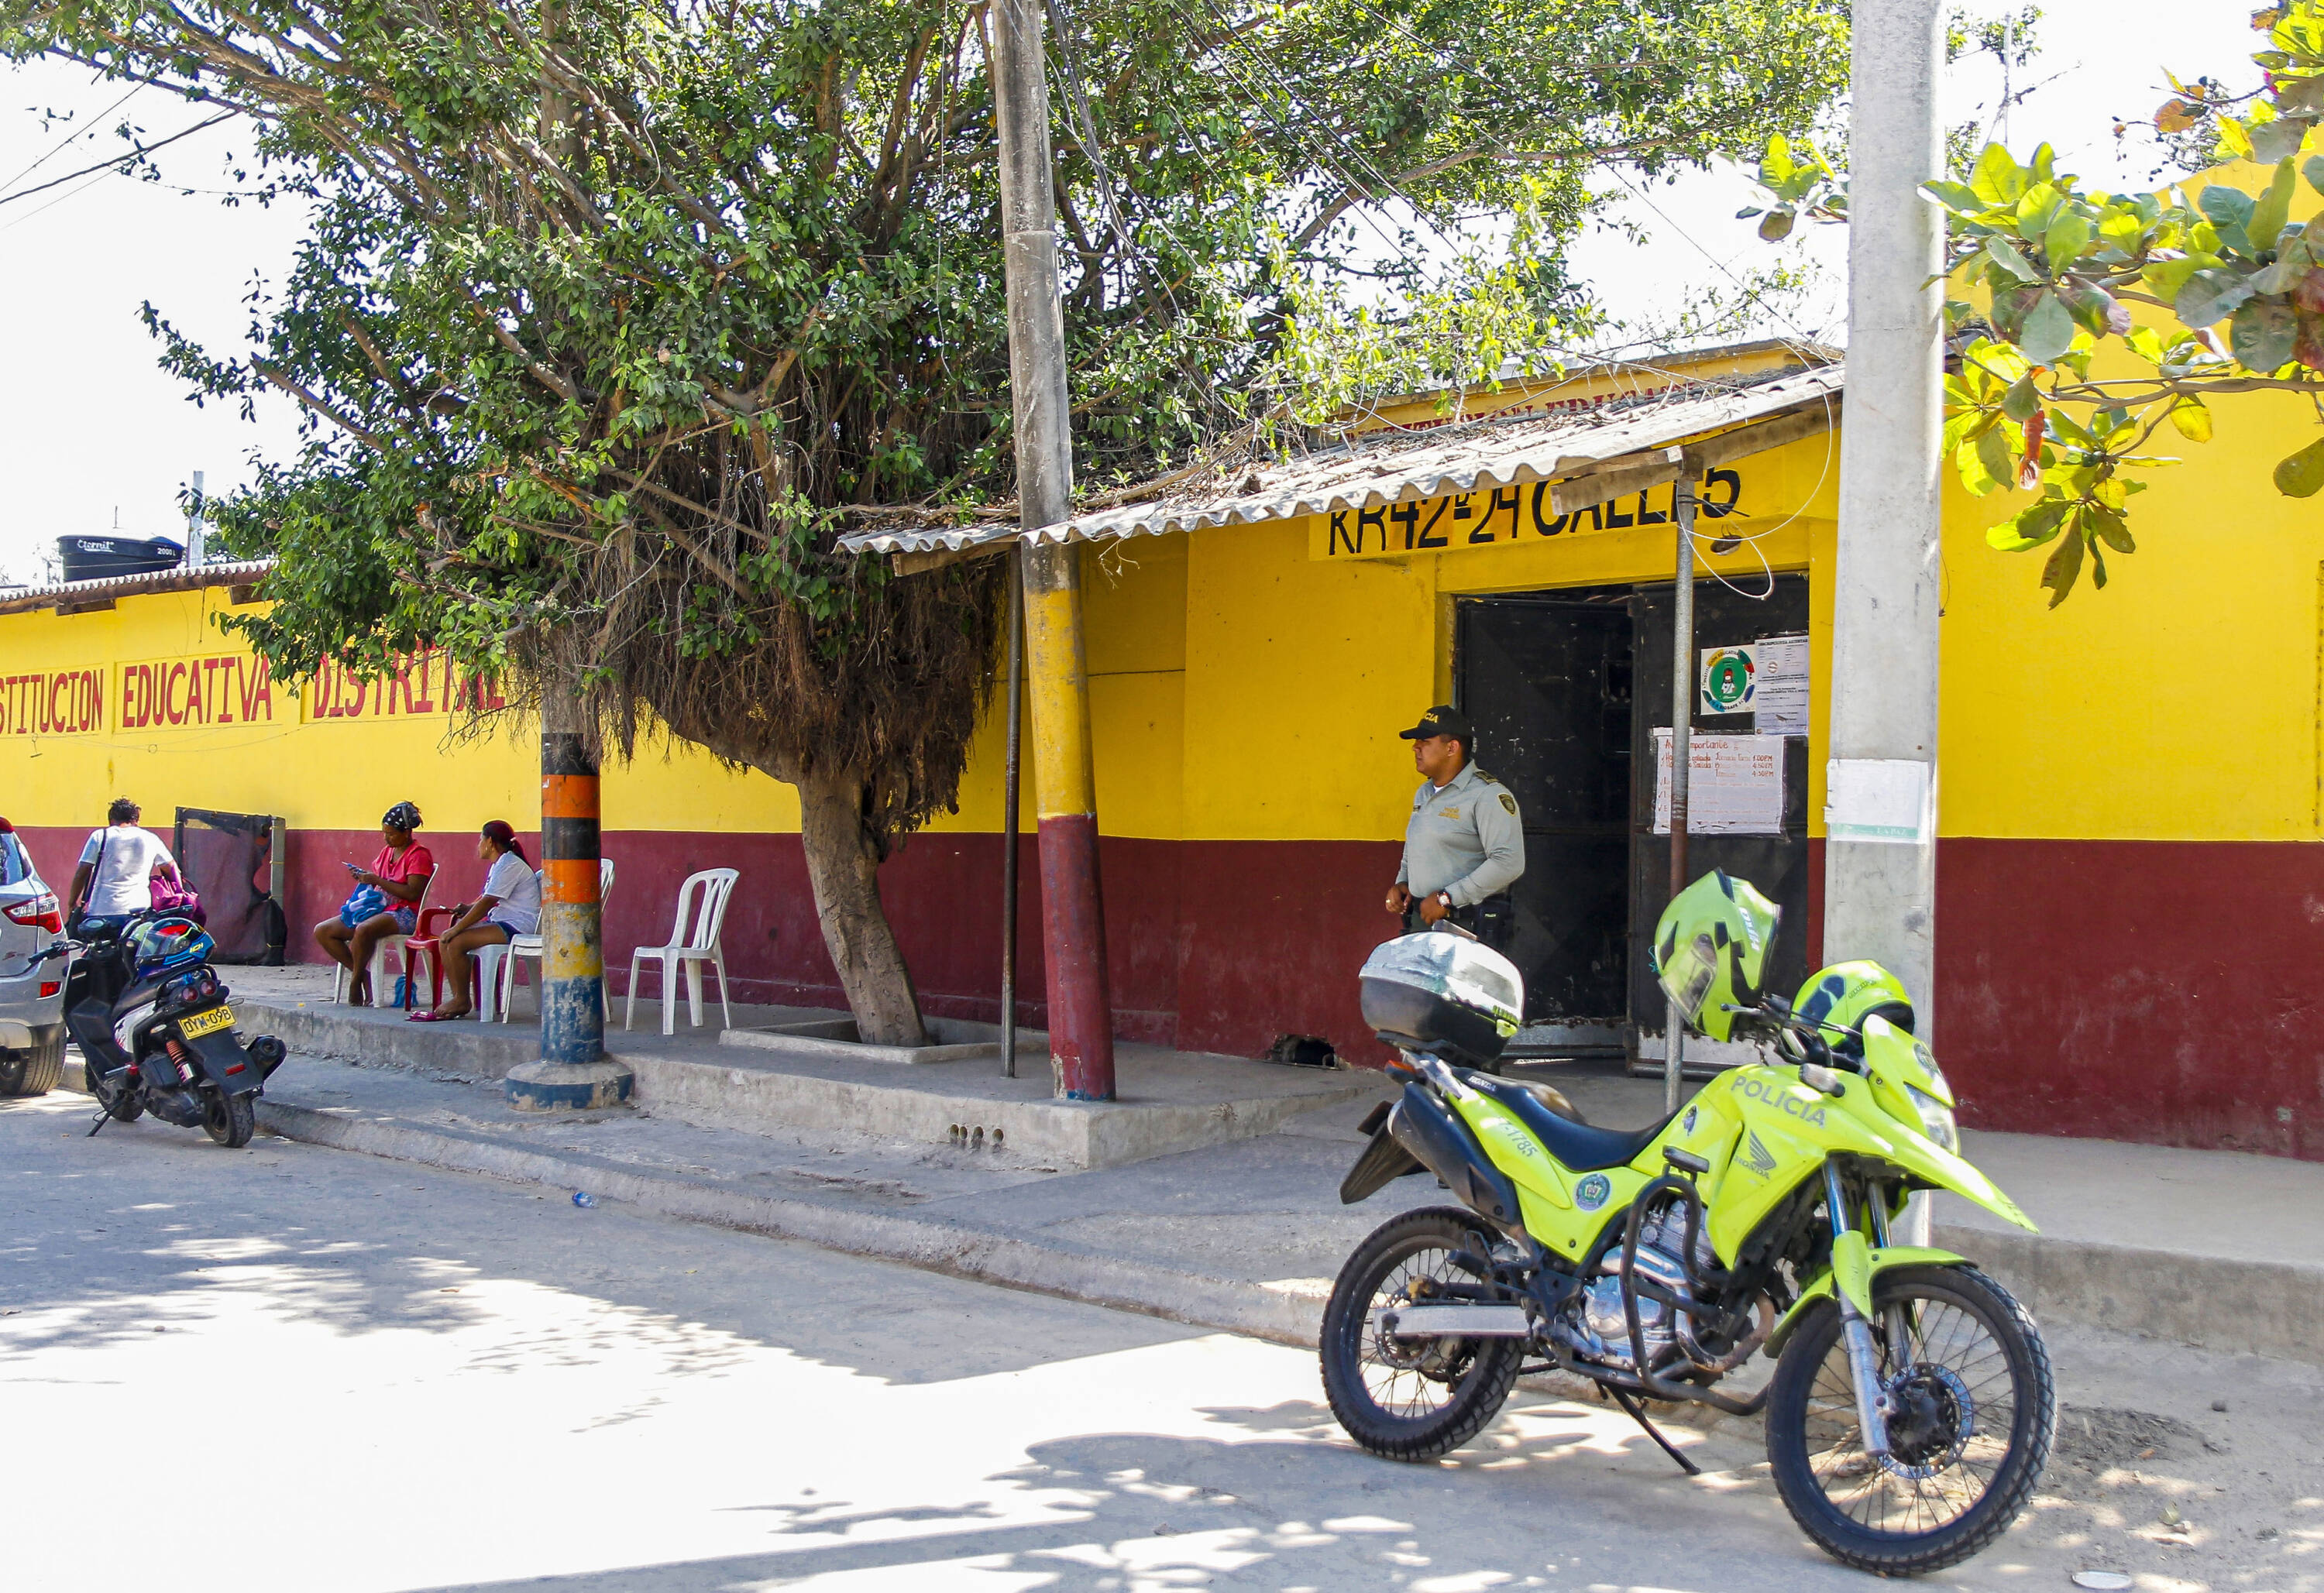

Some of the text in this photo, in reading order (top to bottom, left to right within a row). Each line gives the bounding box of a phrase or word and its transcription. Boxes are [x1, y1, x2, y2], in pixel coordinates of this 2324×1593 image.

[1703, 467, 1741, 519] 5
[157, 547, 173, 556] 2000
[122, 653, 273, 728] EDUCATIVA
[1690, 737, 1728, 751] mportante
[1731, 1075, 1826, 1127] POLICIA
[1734, 1155, 1770, 1180] HONDA
